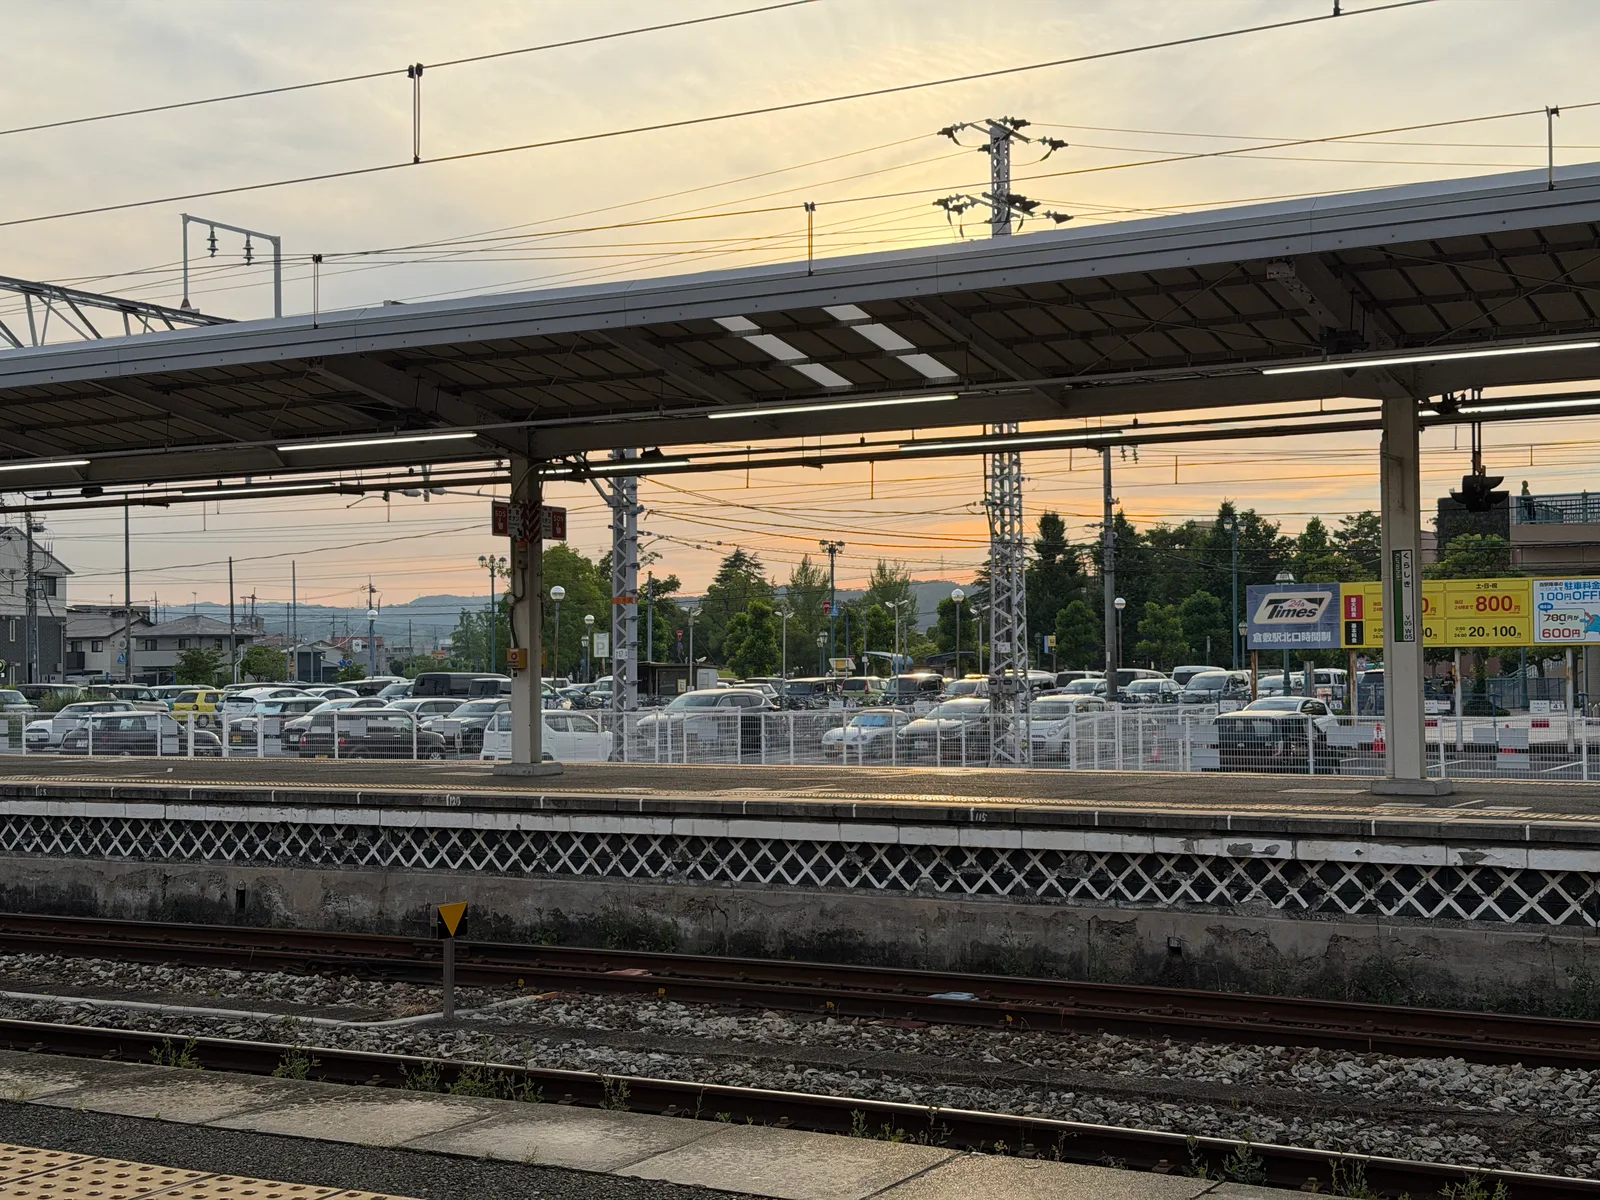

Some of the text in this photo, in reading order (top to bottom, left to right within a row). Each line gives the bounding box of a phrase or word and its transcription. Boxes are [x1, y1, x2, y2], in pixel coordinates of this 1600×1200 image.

[1403, 552, 1411, 588] くらしき
[1267, 605, 1318, 619] Times
[1252, 631, 1331, 643] 倉敷駅北口時間制
[1542, 628, 1580, 638] 600円
[596, 641, 605, 655] P
